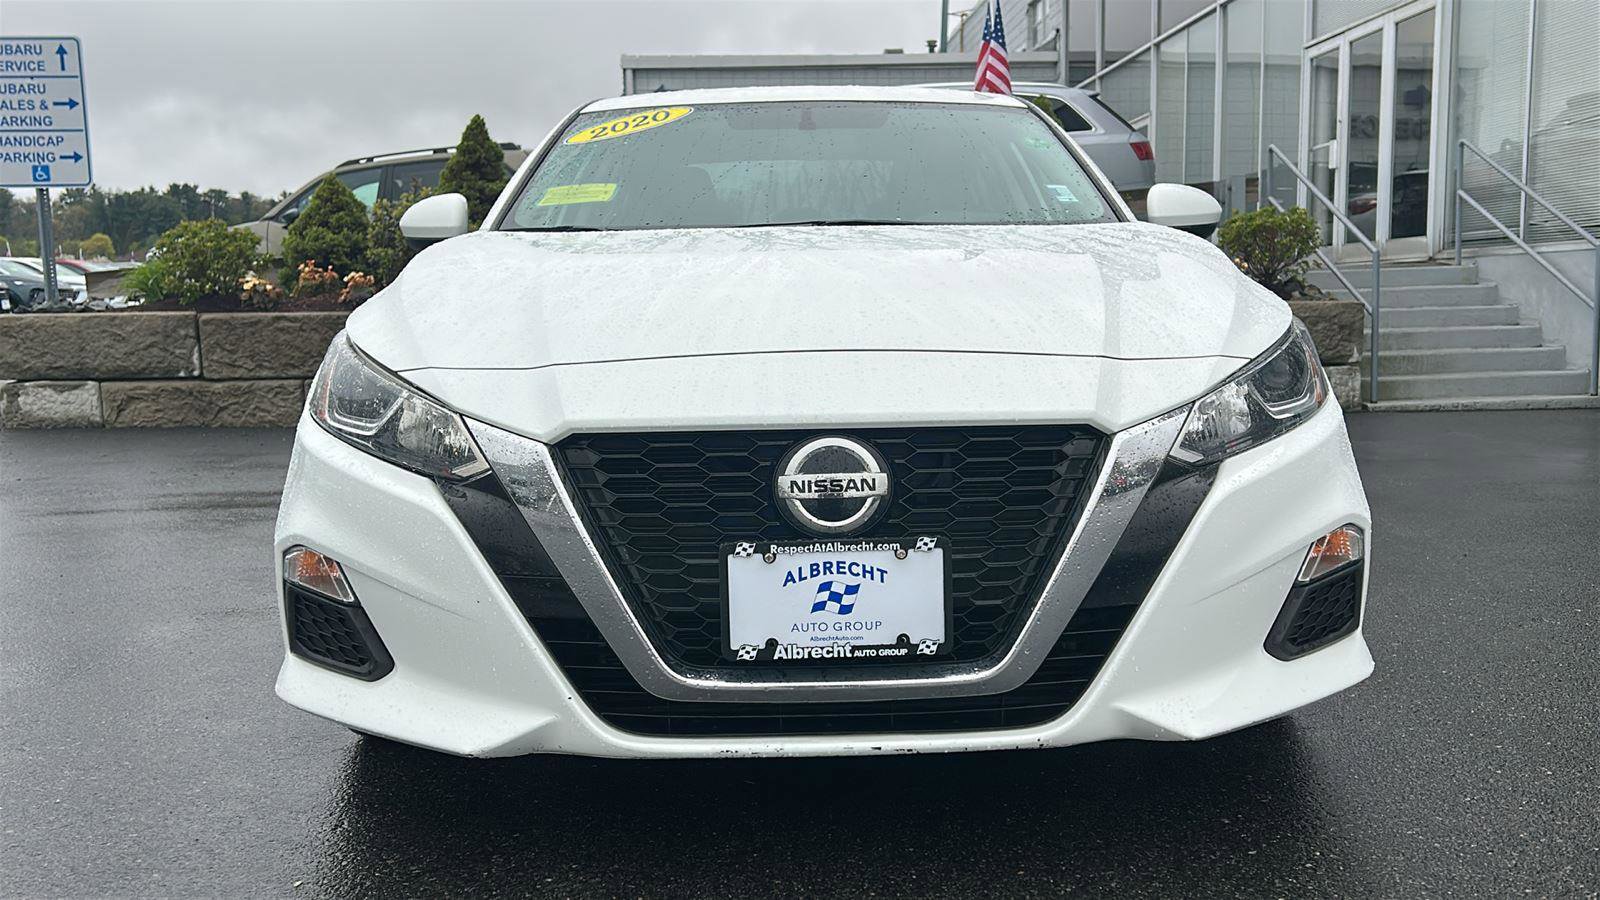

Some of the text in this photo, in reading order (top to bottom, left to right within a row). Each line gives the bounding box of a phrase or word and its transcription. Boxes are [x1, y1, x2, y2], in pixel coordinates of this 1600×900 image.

[0, 83, 46, 95] UBARU
[0, 99, 49, 110] ALES &
[0, 115, 53, 127] ARKING
[590, 110, 670, 139] 2020
[789, 478, 877, 494] NISSAN
[770, 541, 901, 555] RespectAtAlbrecht.com
[782, 560, 888, 587] ALBRECHT
[791, 620, 882, 633] AUTO GROUP
[773, 642, 909, 660] Albrecht AUTO GROUP
